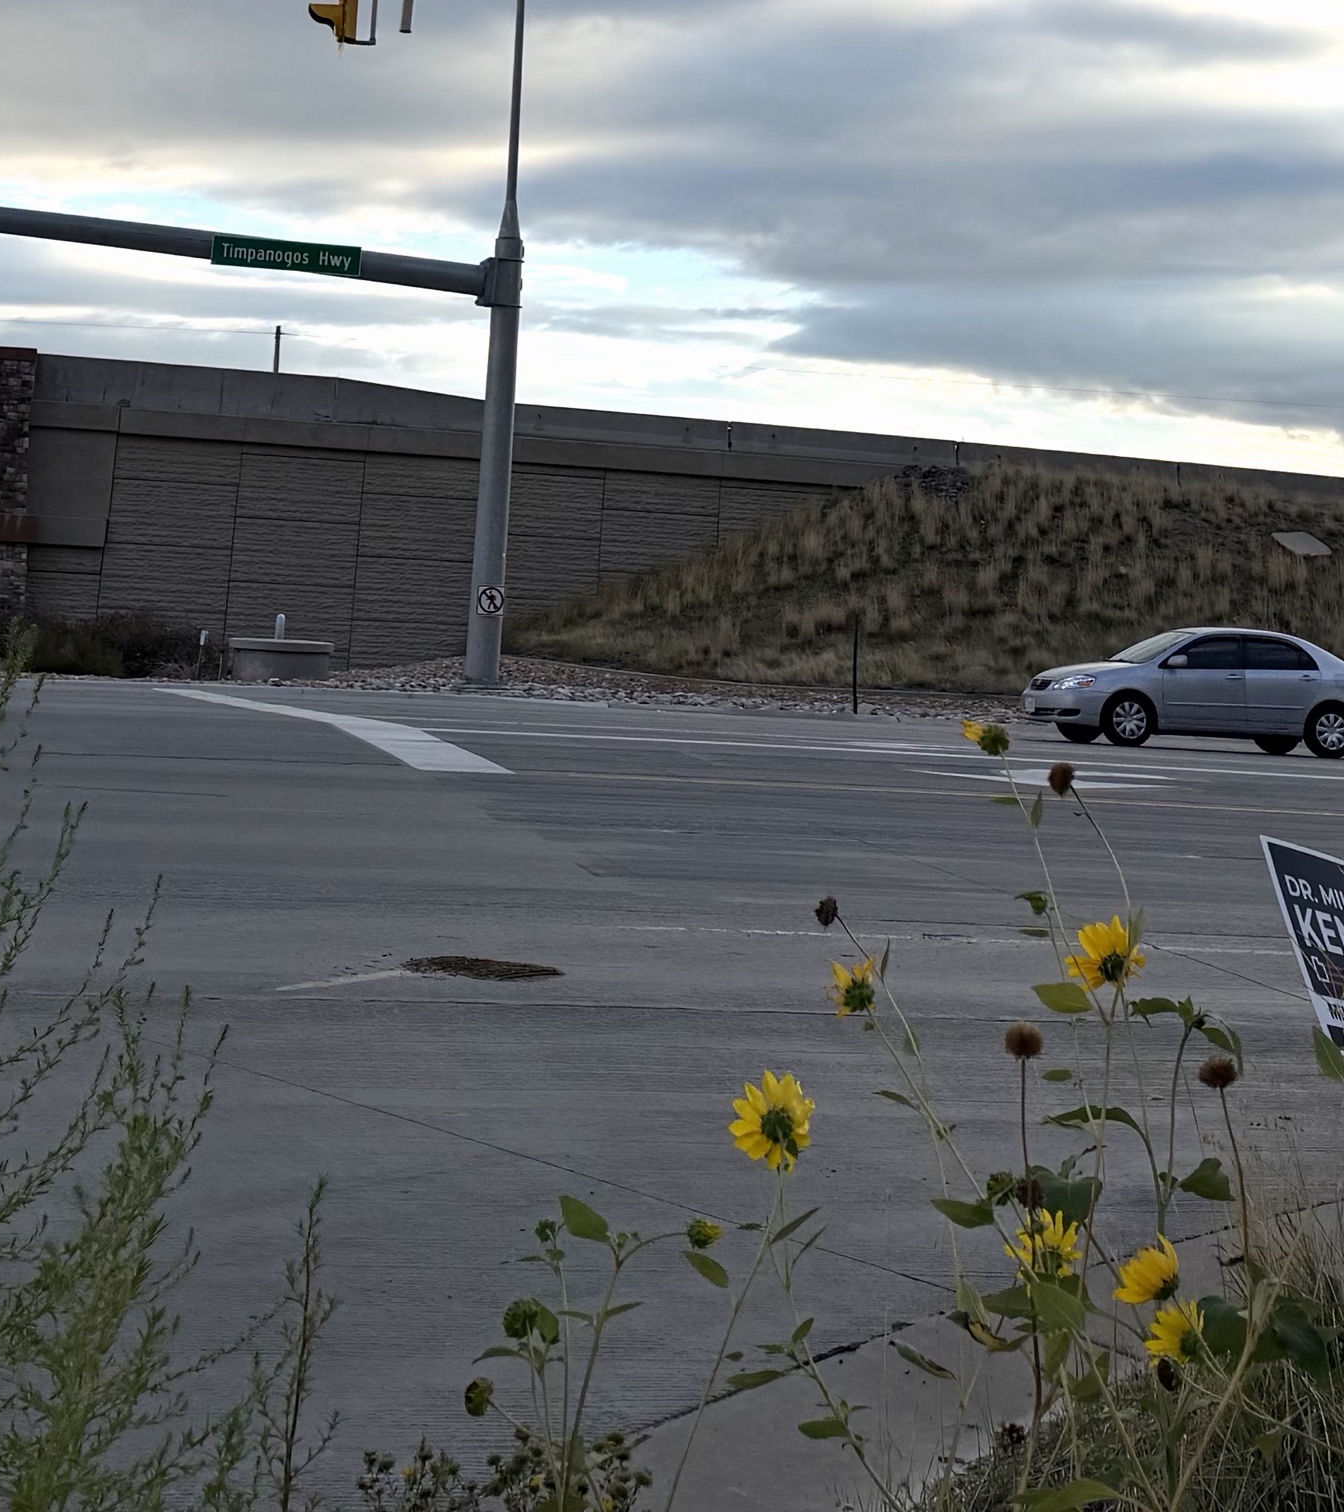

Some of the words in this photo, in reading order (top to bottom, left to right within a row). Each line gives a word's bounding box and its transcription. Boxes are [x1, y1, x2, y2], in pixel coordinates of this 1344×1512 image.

[221, 242, 309, 267] Timpanogos
[319, 250, 352, 271] Hwy
[1284, 874, 1319, 903] DR.
